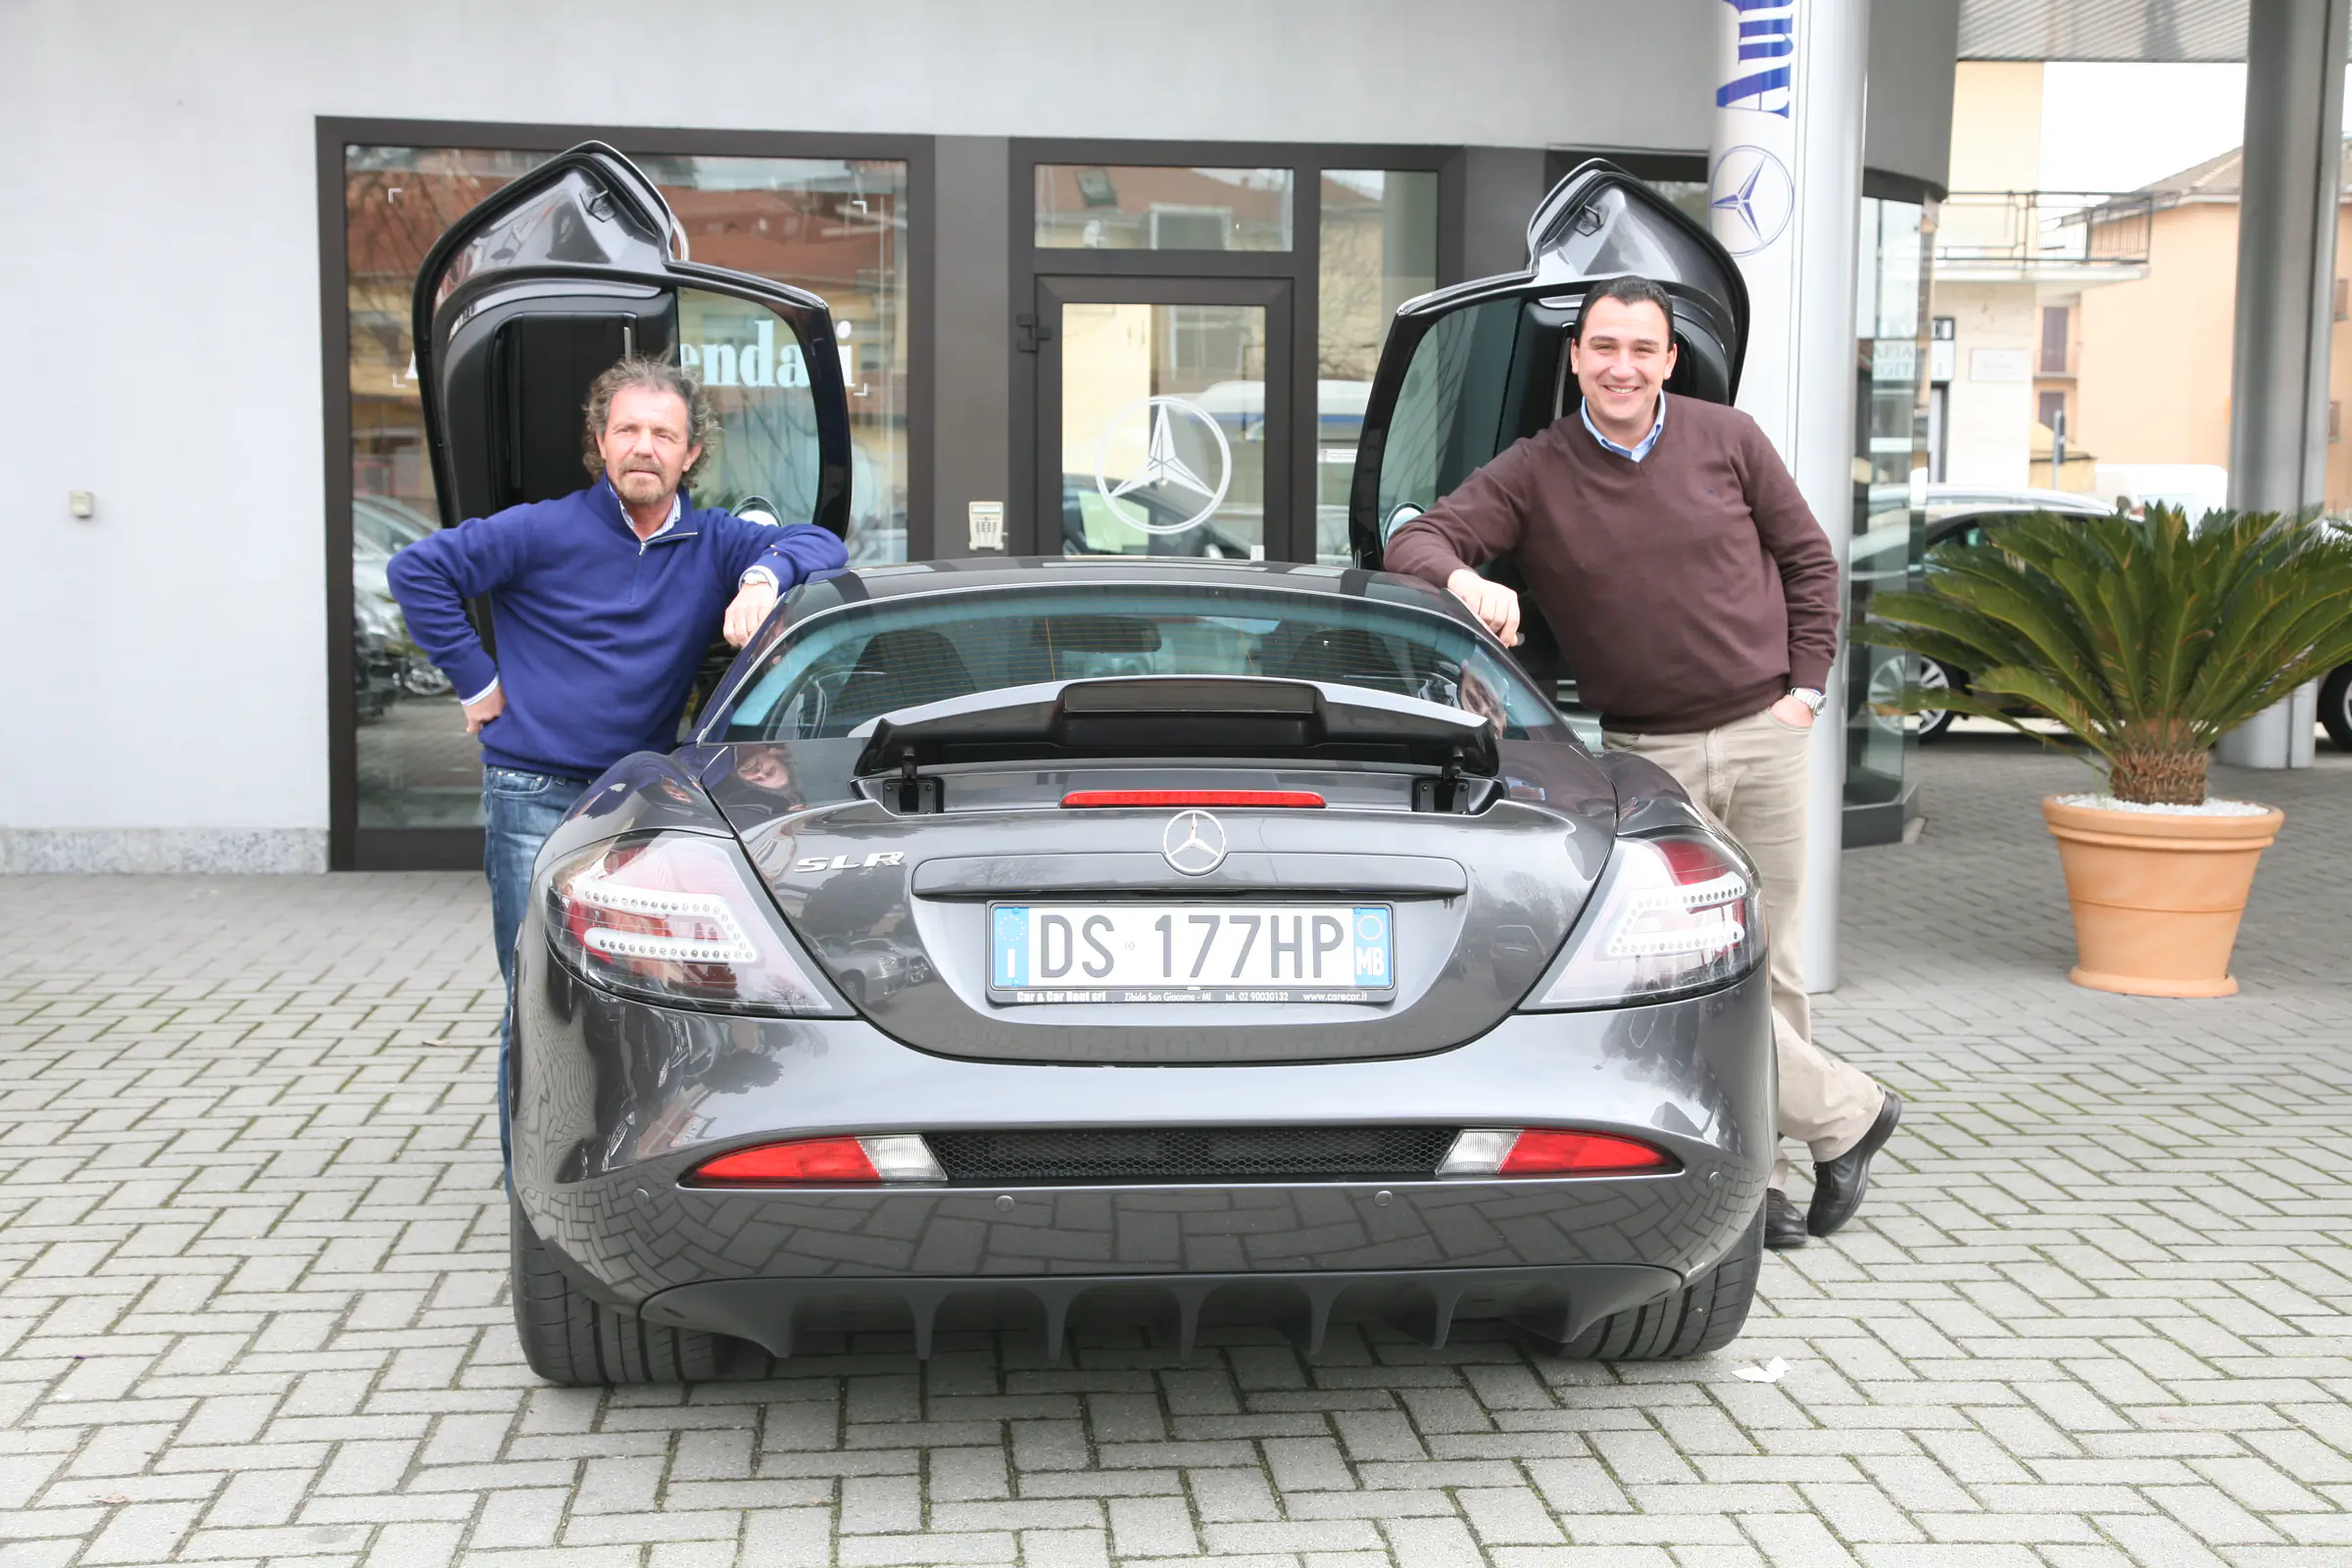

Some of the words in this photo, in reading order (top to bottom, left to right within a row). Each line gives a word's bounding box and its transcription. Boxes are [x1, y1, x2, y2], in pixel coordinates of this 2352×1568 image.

[794, 851, 906, 873] SLR
[1040, 914, 1115, 979] DS
[1154, 914, 1345, 979] 177HP
[1356, 947, 1386, 977] MB
[1017, 991, 1035, 1002] Car
[1047, 991, 1064, 1002] Car
[1124, 992, 1147, 1002] Zibido
[1148, 992, 1161, 1002] San
[1163, 992, 1195, 1002] Giacomo
[1239, 992, 1249, 1001] 02
[1302, 991, 1368, 1001] www.carecar.it
